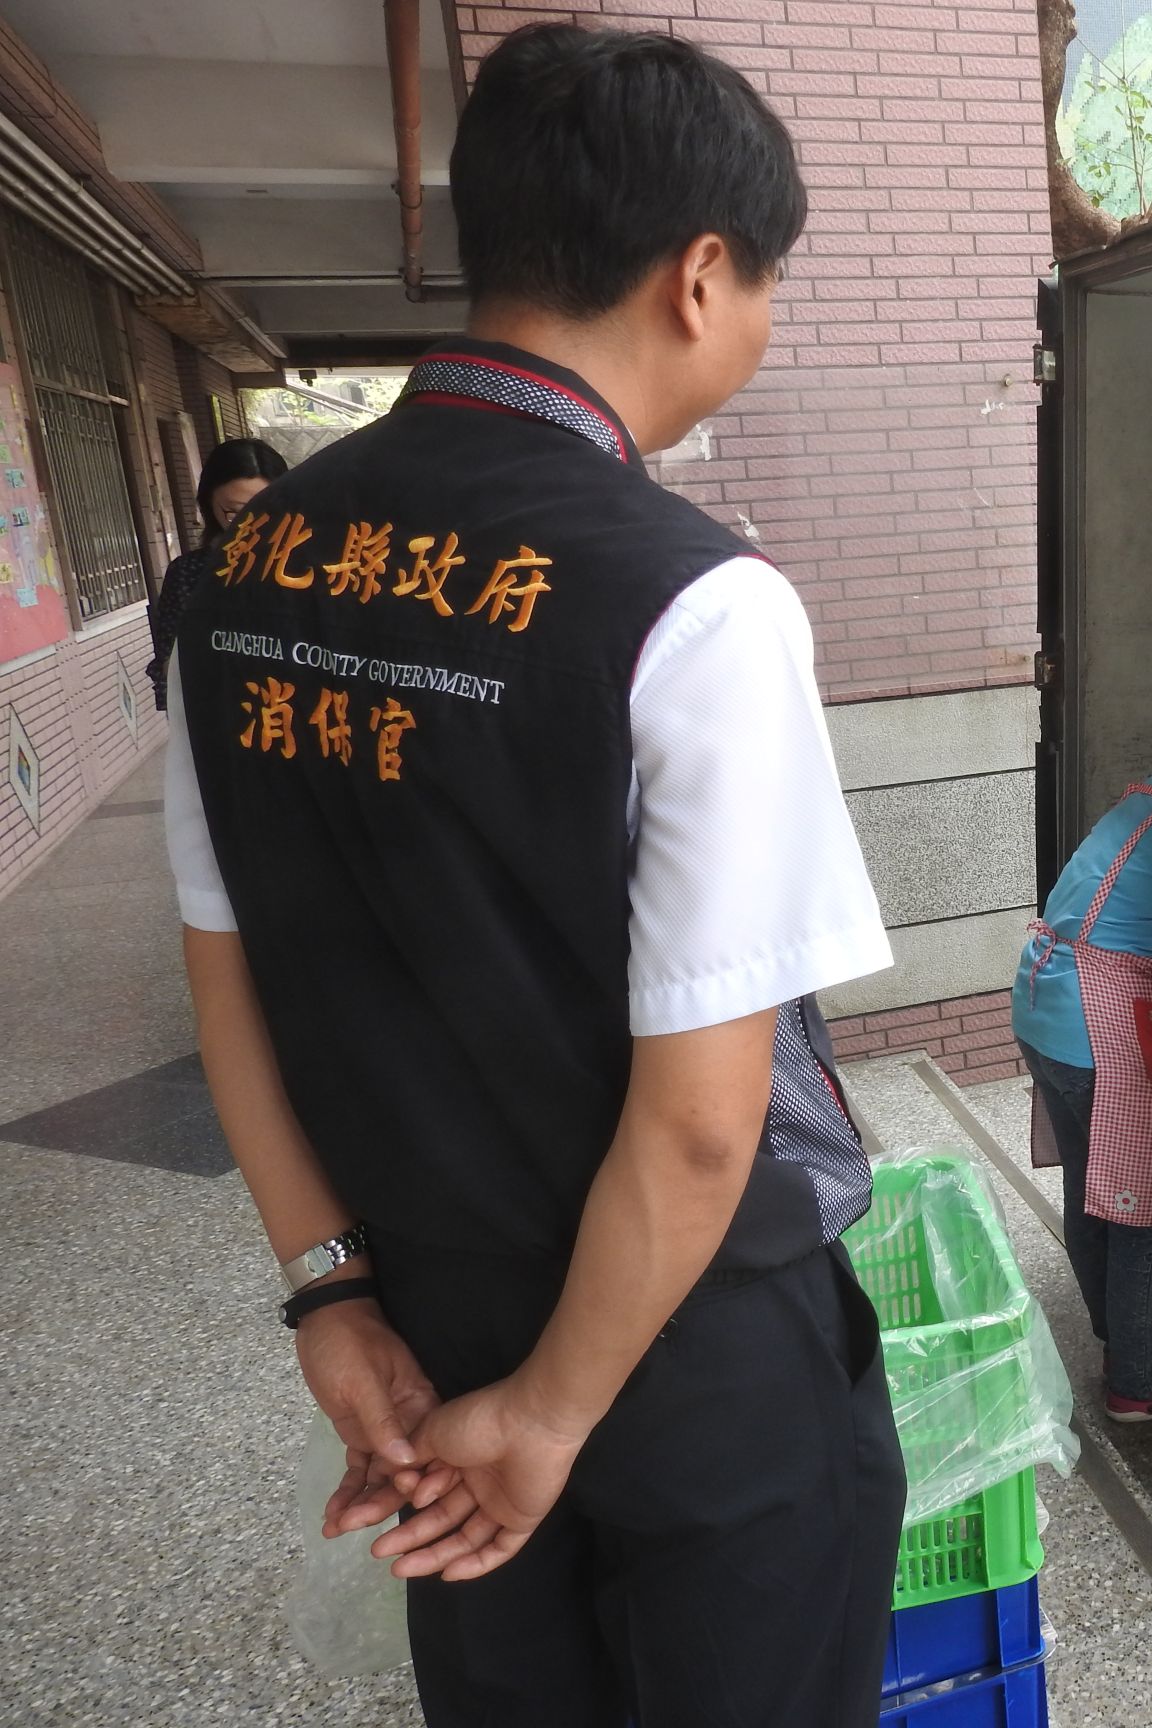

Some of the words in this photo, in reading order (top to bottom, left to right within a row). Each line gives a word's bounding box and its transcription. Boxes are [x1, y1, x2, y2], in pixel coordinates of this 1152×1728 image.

[215, 512, 553, 633] 彰化縣政府
[292, 642, 367, 676] COUNTY
[368, 659, 505, 704] GOVERNMENT
[240, 676, 417, 781] 消保官
